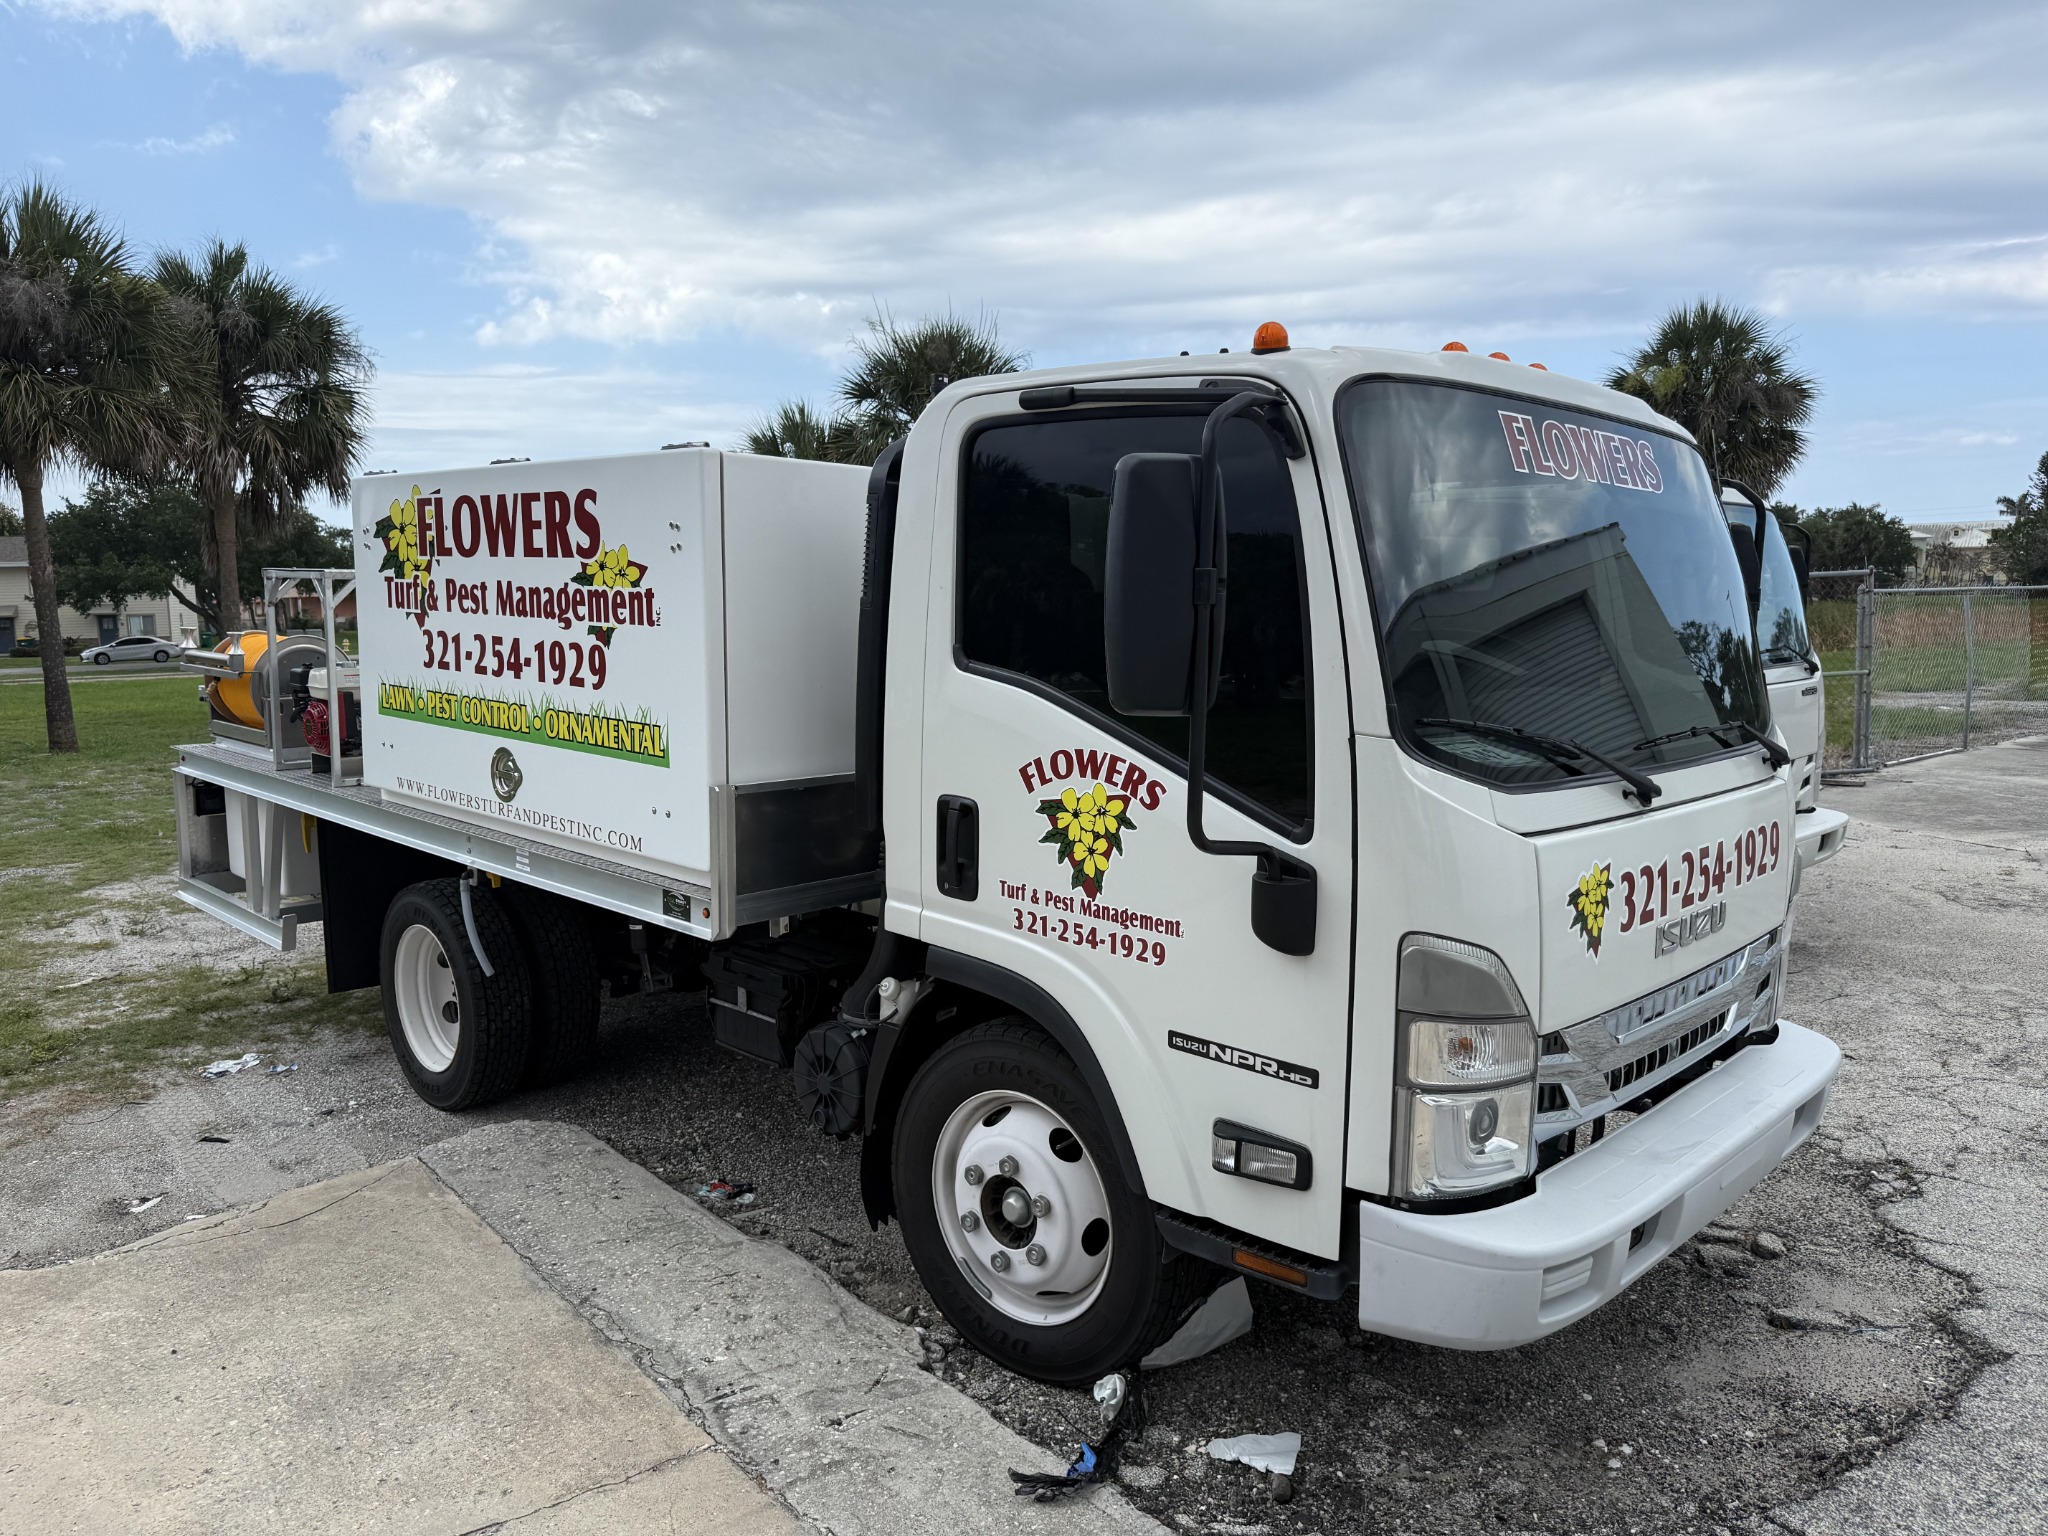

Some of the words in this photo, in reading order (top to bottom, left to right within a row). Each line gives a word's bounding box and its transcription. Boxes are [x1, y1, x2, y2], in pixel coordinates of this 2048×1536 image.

[1497, 410, 1664, 494] FLOWERS
[416, 488, 601, 559] FLOWERS
[384, 575, 421, 611] Turf
[425, 587, 439, 612] &
[446, 578, 488, 615] Pest
[496, 580, 655, 630] Management
[423, 629, 607, 690] 321-254-1929
[381, 682, 415, 713] LAWN
[427, 689, 458, 721] PEST
[461, 695, 530, 735] CONTROL
[545, 709, 665, 758] ORNAMENTAL
[1018, 748, 1167, 811] FLOWERS
[396, 776, 643, 853] WWW.FLOWERSTURFANDPESTINC.COM
[1620, 820, 1780, 933] 321-254-1929
[999, 879, 1027, 902] Turf
[1030, 888, 1040, 904] &
[1044, 890, 1074, 914] Pest
[1079, 898, 1181, 938] Management
[1013, 907, 1166, 966] 321-254-1929
[1654, 900, 1727, 959] ISUZU
[1172, 1036, 1207, 1053] ISUZU
[1209, 1043, 1279, 1077] NPR
[1278, 1069, 1312, 1085] HD
